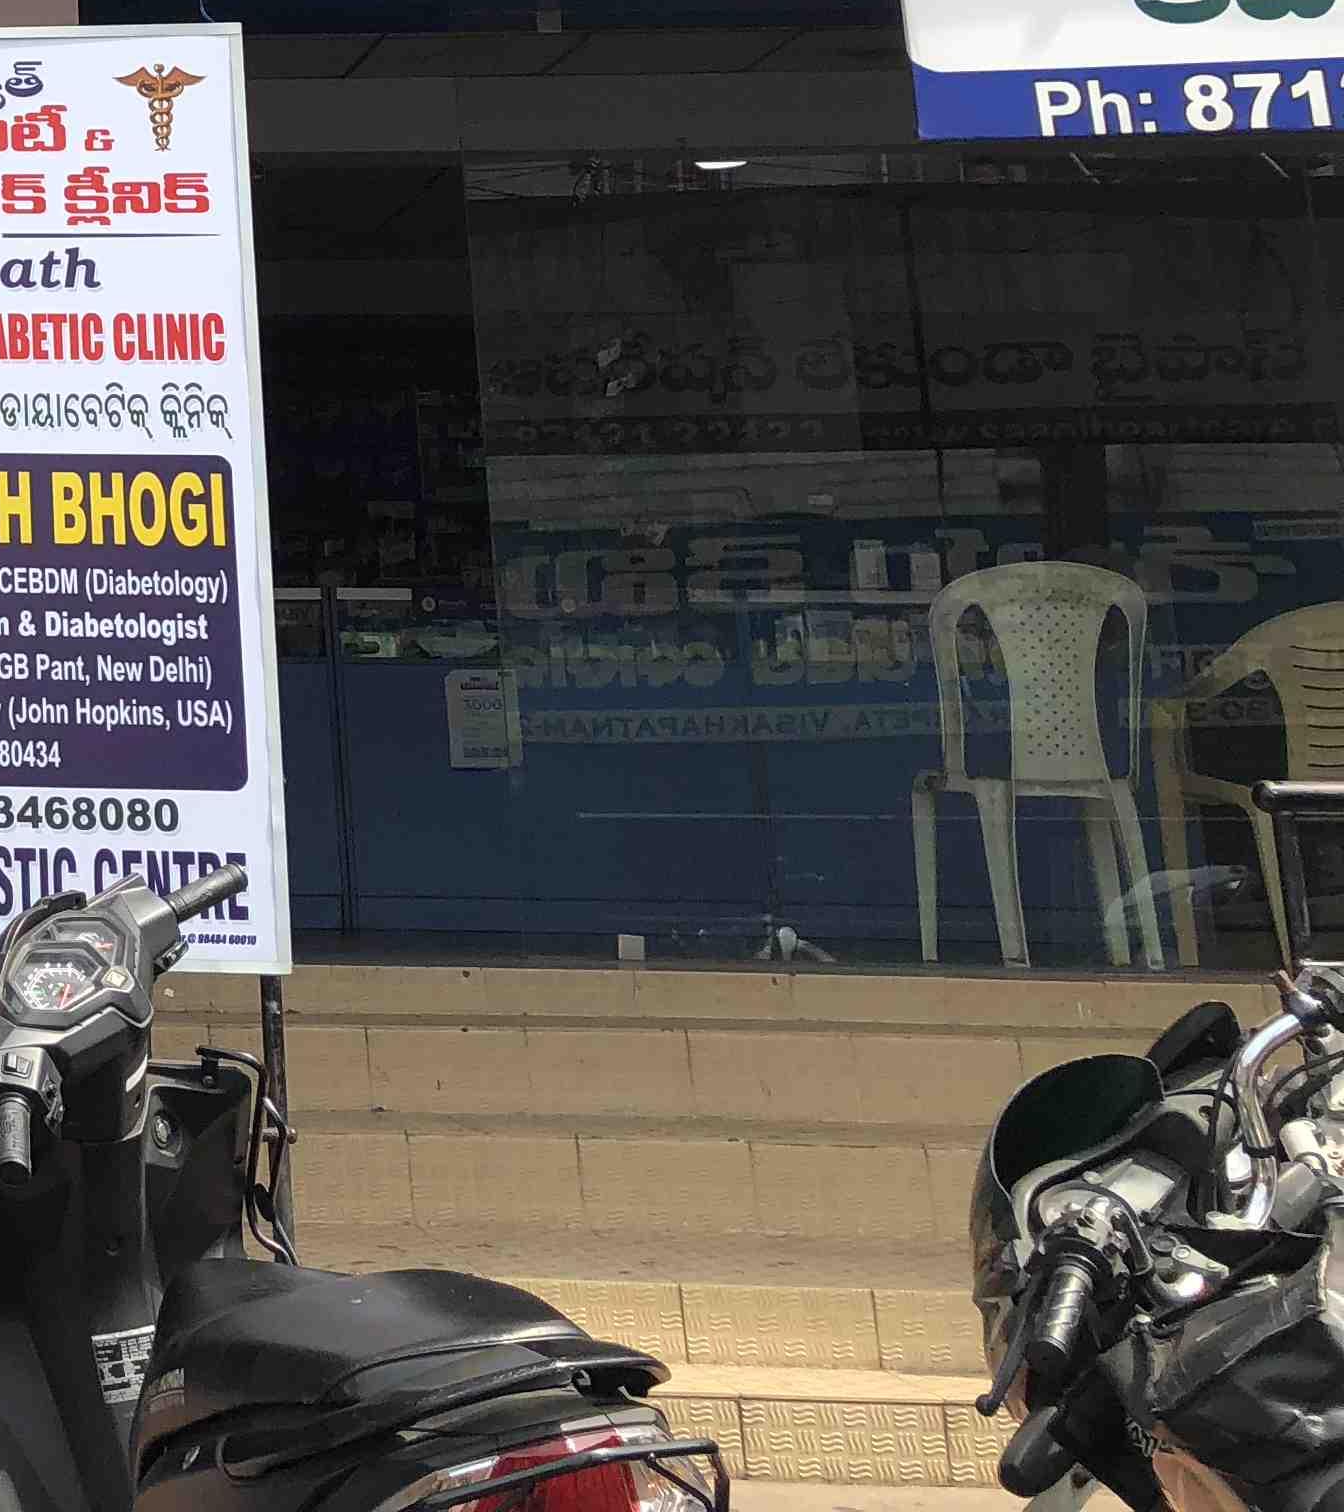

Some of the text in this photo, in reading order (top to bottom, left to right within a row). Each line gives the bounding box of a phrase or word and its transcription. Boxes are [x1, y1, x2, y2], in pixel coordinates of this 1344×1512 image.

[1035, 80, 1158, 137] Ph:
[112, 313, 226, 363] CLINIC
[52, 470, 226, 548] BHOGI
[84, 569, 229, 603] (Diabetology)
[18, 613, 36, 637] &
[44, 611, 208, 646] Diabetologist
